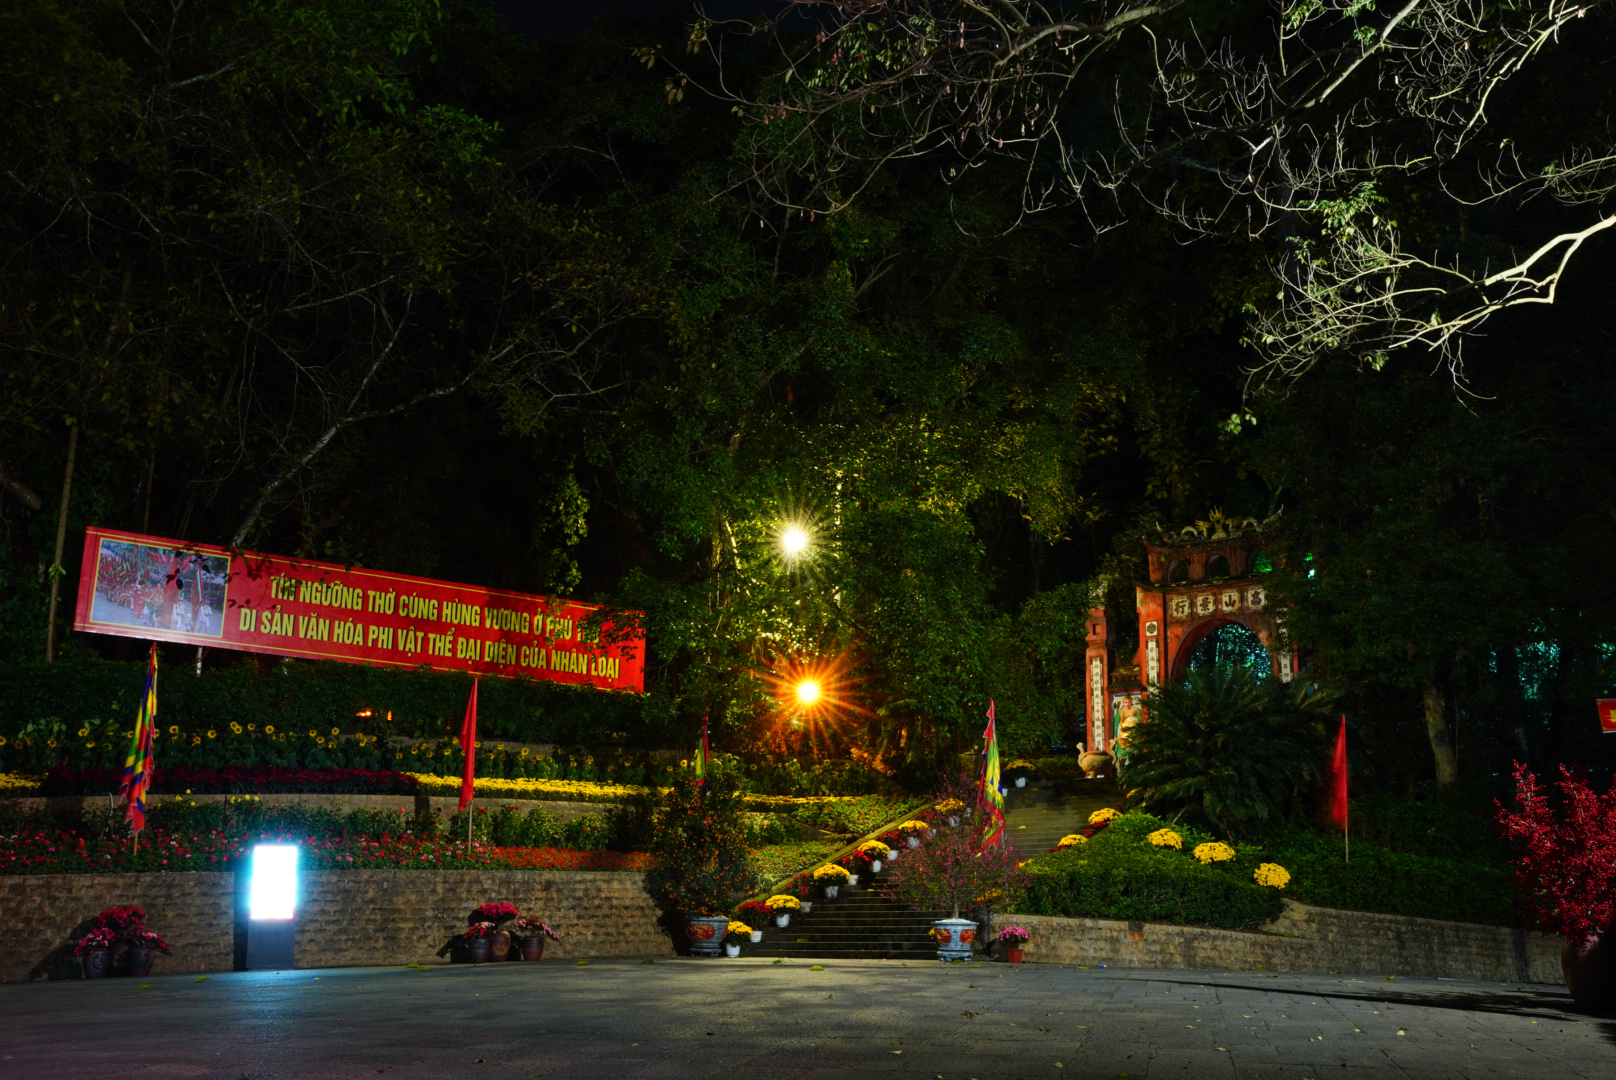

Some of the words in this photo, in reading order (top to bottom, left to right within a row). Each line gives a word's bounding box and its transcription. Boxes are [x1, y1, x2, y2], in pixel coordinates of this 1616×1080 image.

[299, 580, 363, 611] NGƯỠNG
[367, 588, 397, 615] THỜ
[398, 592, 438, 621] CÚNG
[442, 598, 481, 627] HÙNG
[485, 607, 530, 634] VƯƠNG
[533, 608, 543, 636] Ở
[239, 608, 257, 632] DI
[260, 605, 295, 637] SẢN
[298, 612, 330, 641] VĂN
[333, 617, 364, 646] HÓA
[367, 625, 394, 649] PHI
[397, 626, 425, 657] VẬT
[428, 627, 456, 658] THỂ
[456, 636, 482, 665] ĐẠI
[484, 638, 518, 669] DIỆN
[520, 640, 547, 669] CỦA
[550, 648, 588, 675] NHÂN
[591, 655, 620, 683] LOẠI
